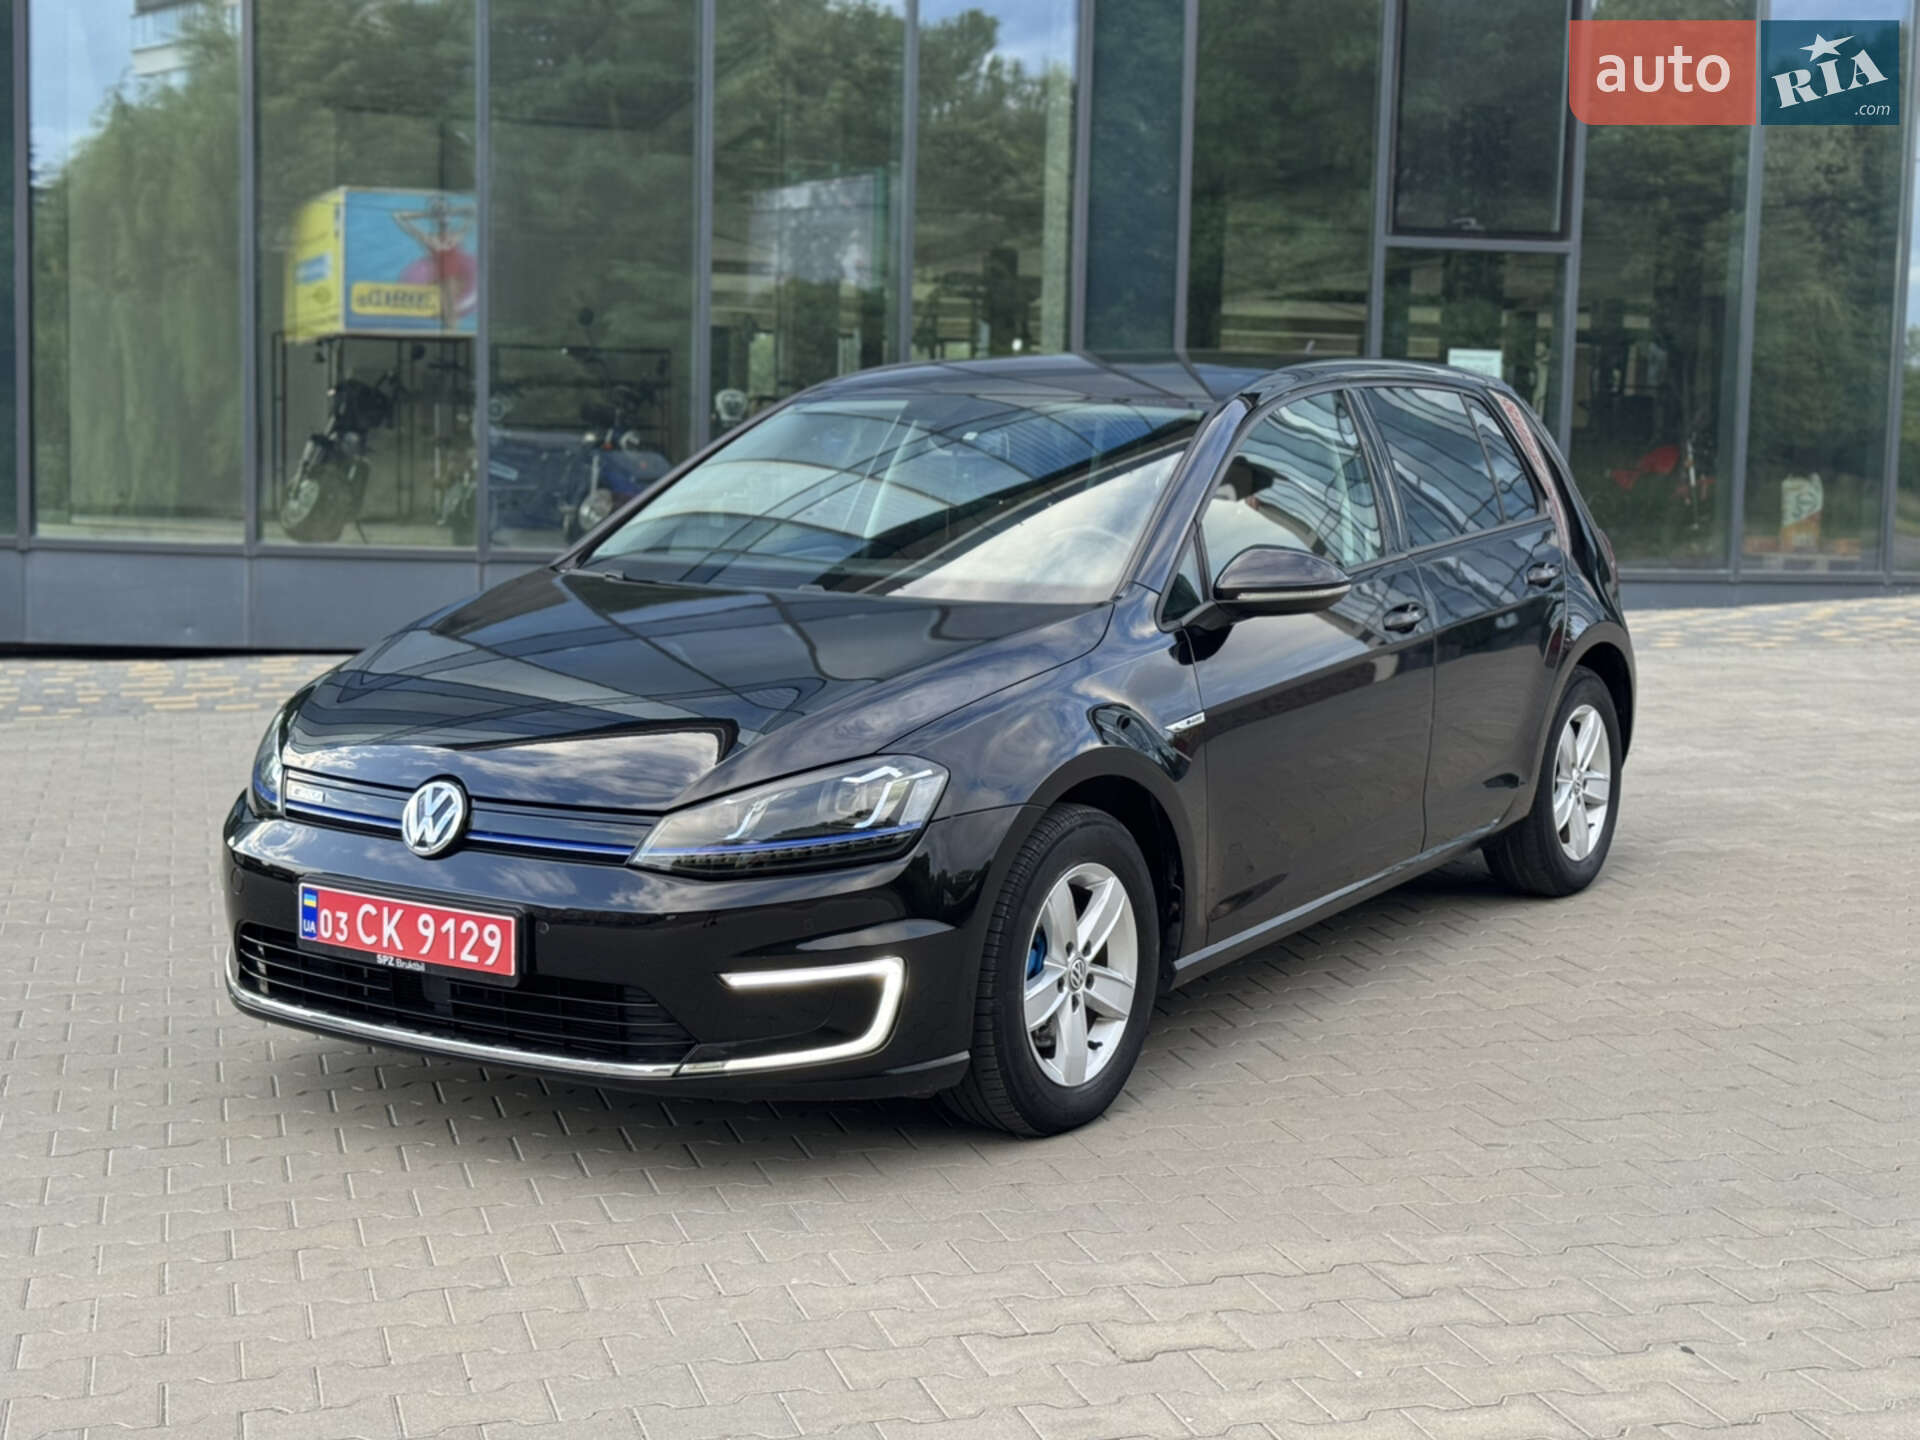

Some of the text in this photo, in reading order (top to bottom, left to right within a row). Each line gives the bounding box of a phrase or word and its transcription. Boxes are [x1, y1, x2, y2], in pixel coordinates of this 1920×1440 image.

[303, 919, 317, 934] UA
[319, 903, 502, 966] 03 CK 9129
